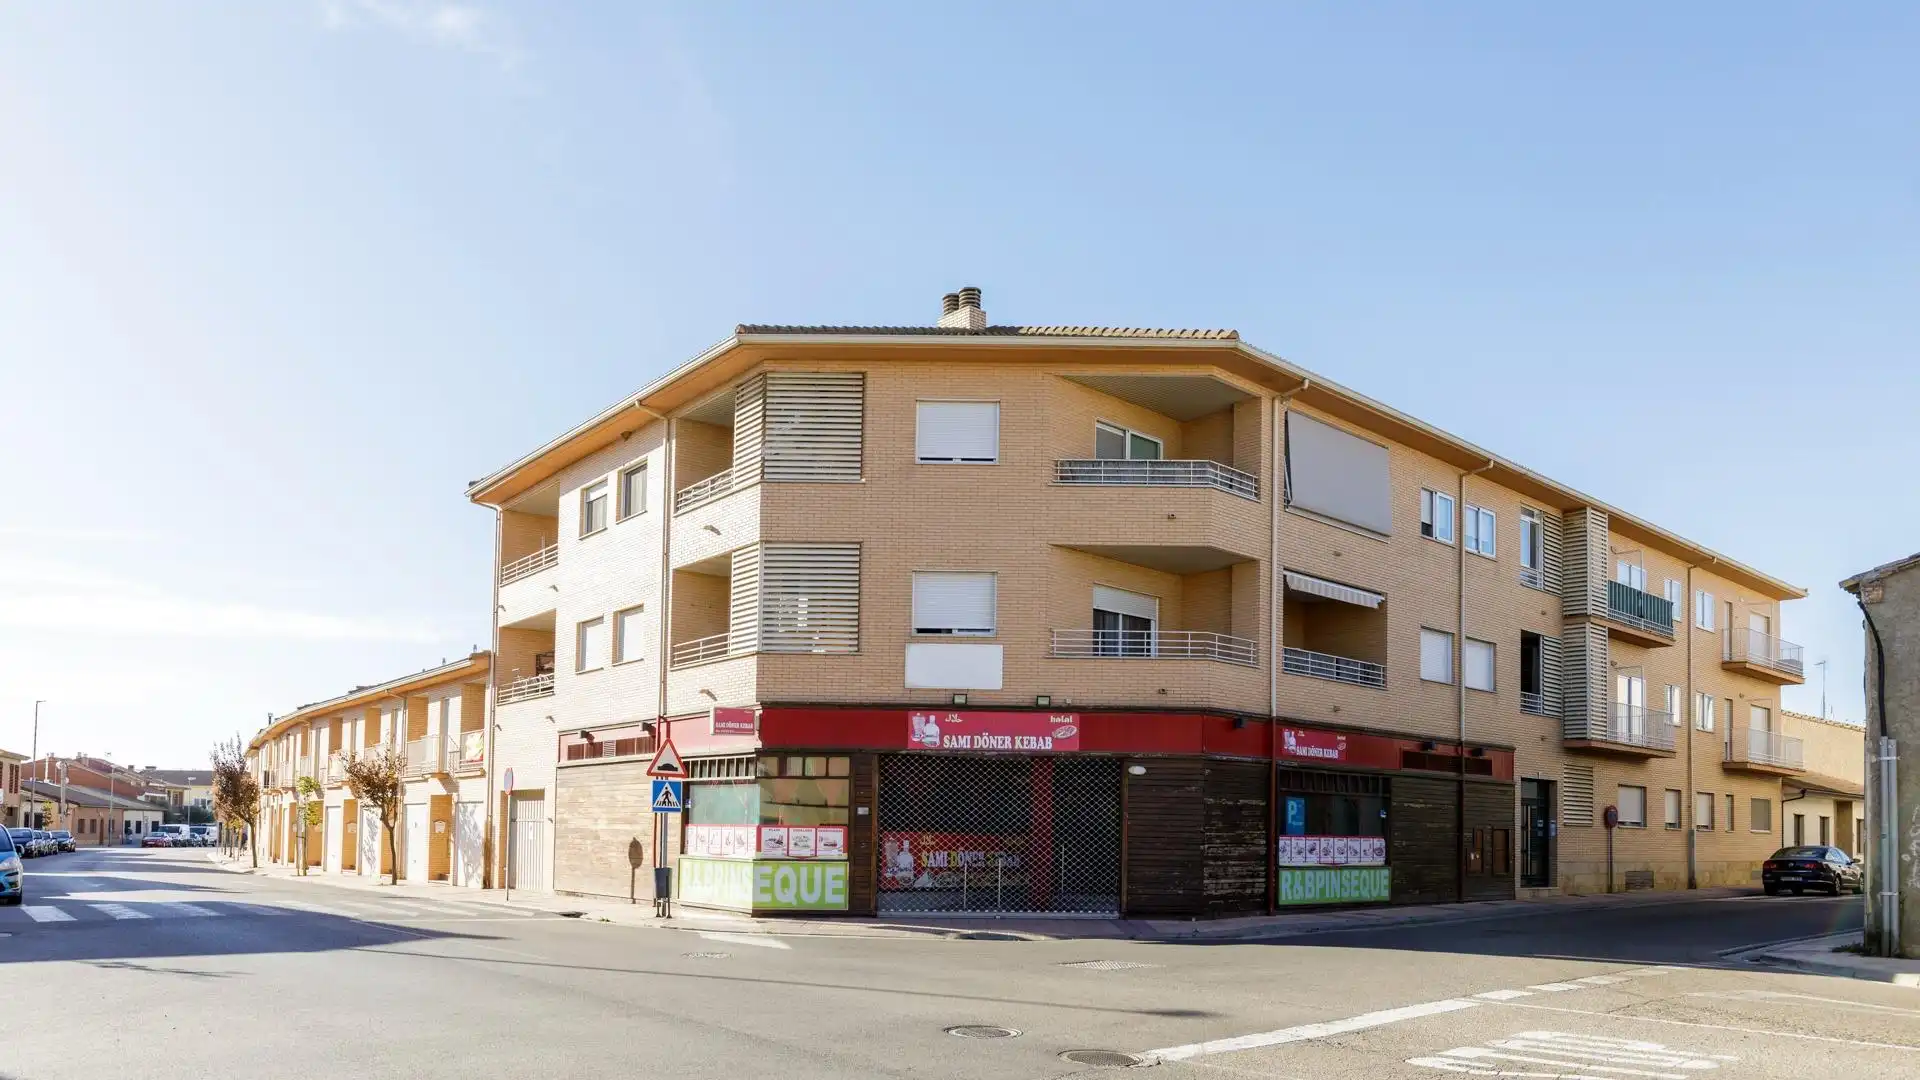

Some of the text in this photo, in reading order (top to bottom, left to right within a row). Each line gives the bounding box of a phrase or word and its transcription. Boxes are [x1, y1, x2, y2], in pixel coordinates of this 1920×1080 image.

[1050, 715, 1073, 723] halal
[943, 732, 1053, 750] SAMI DÖNER KEBAB
[921, 850, 948, 868] SAMI
